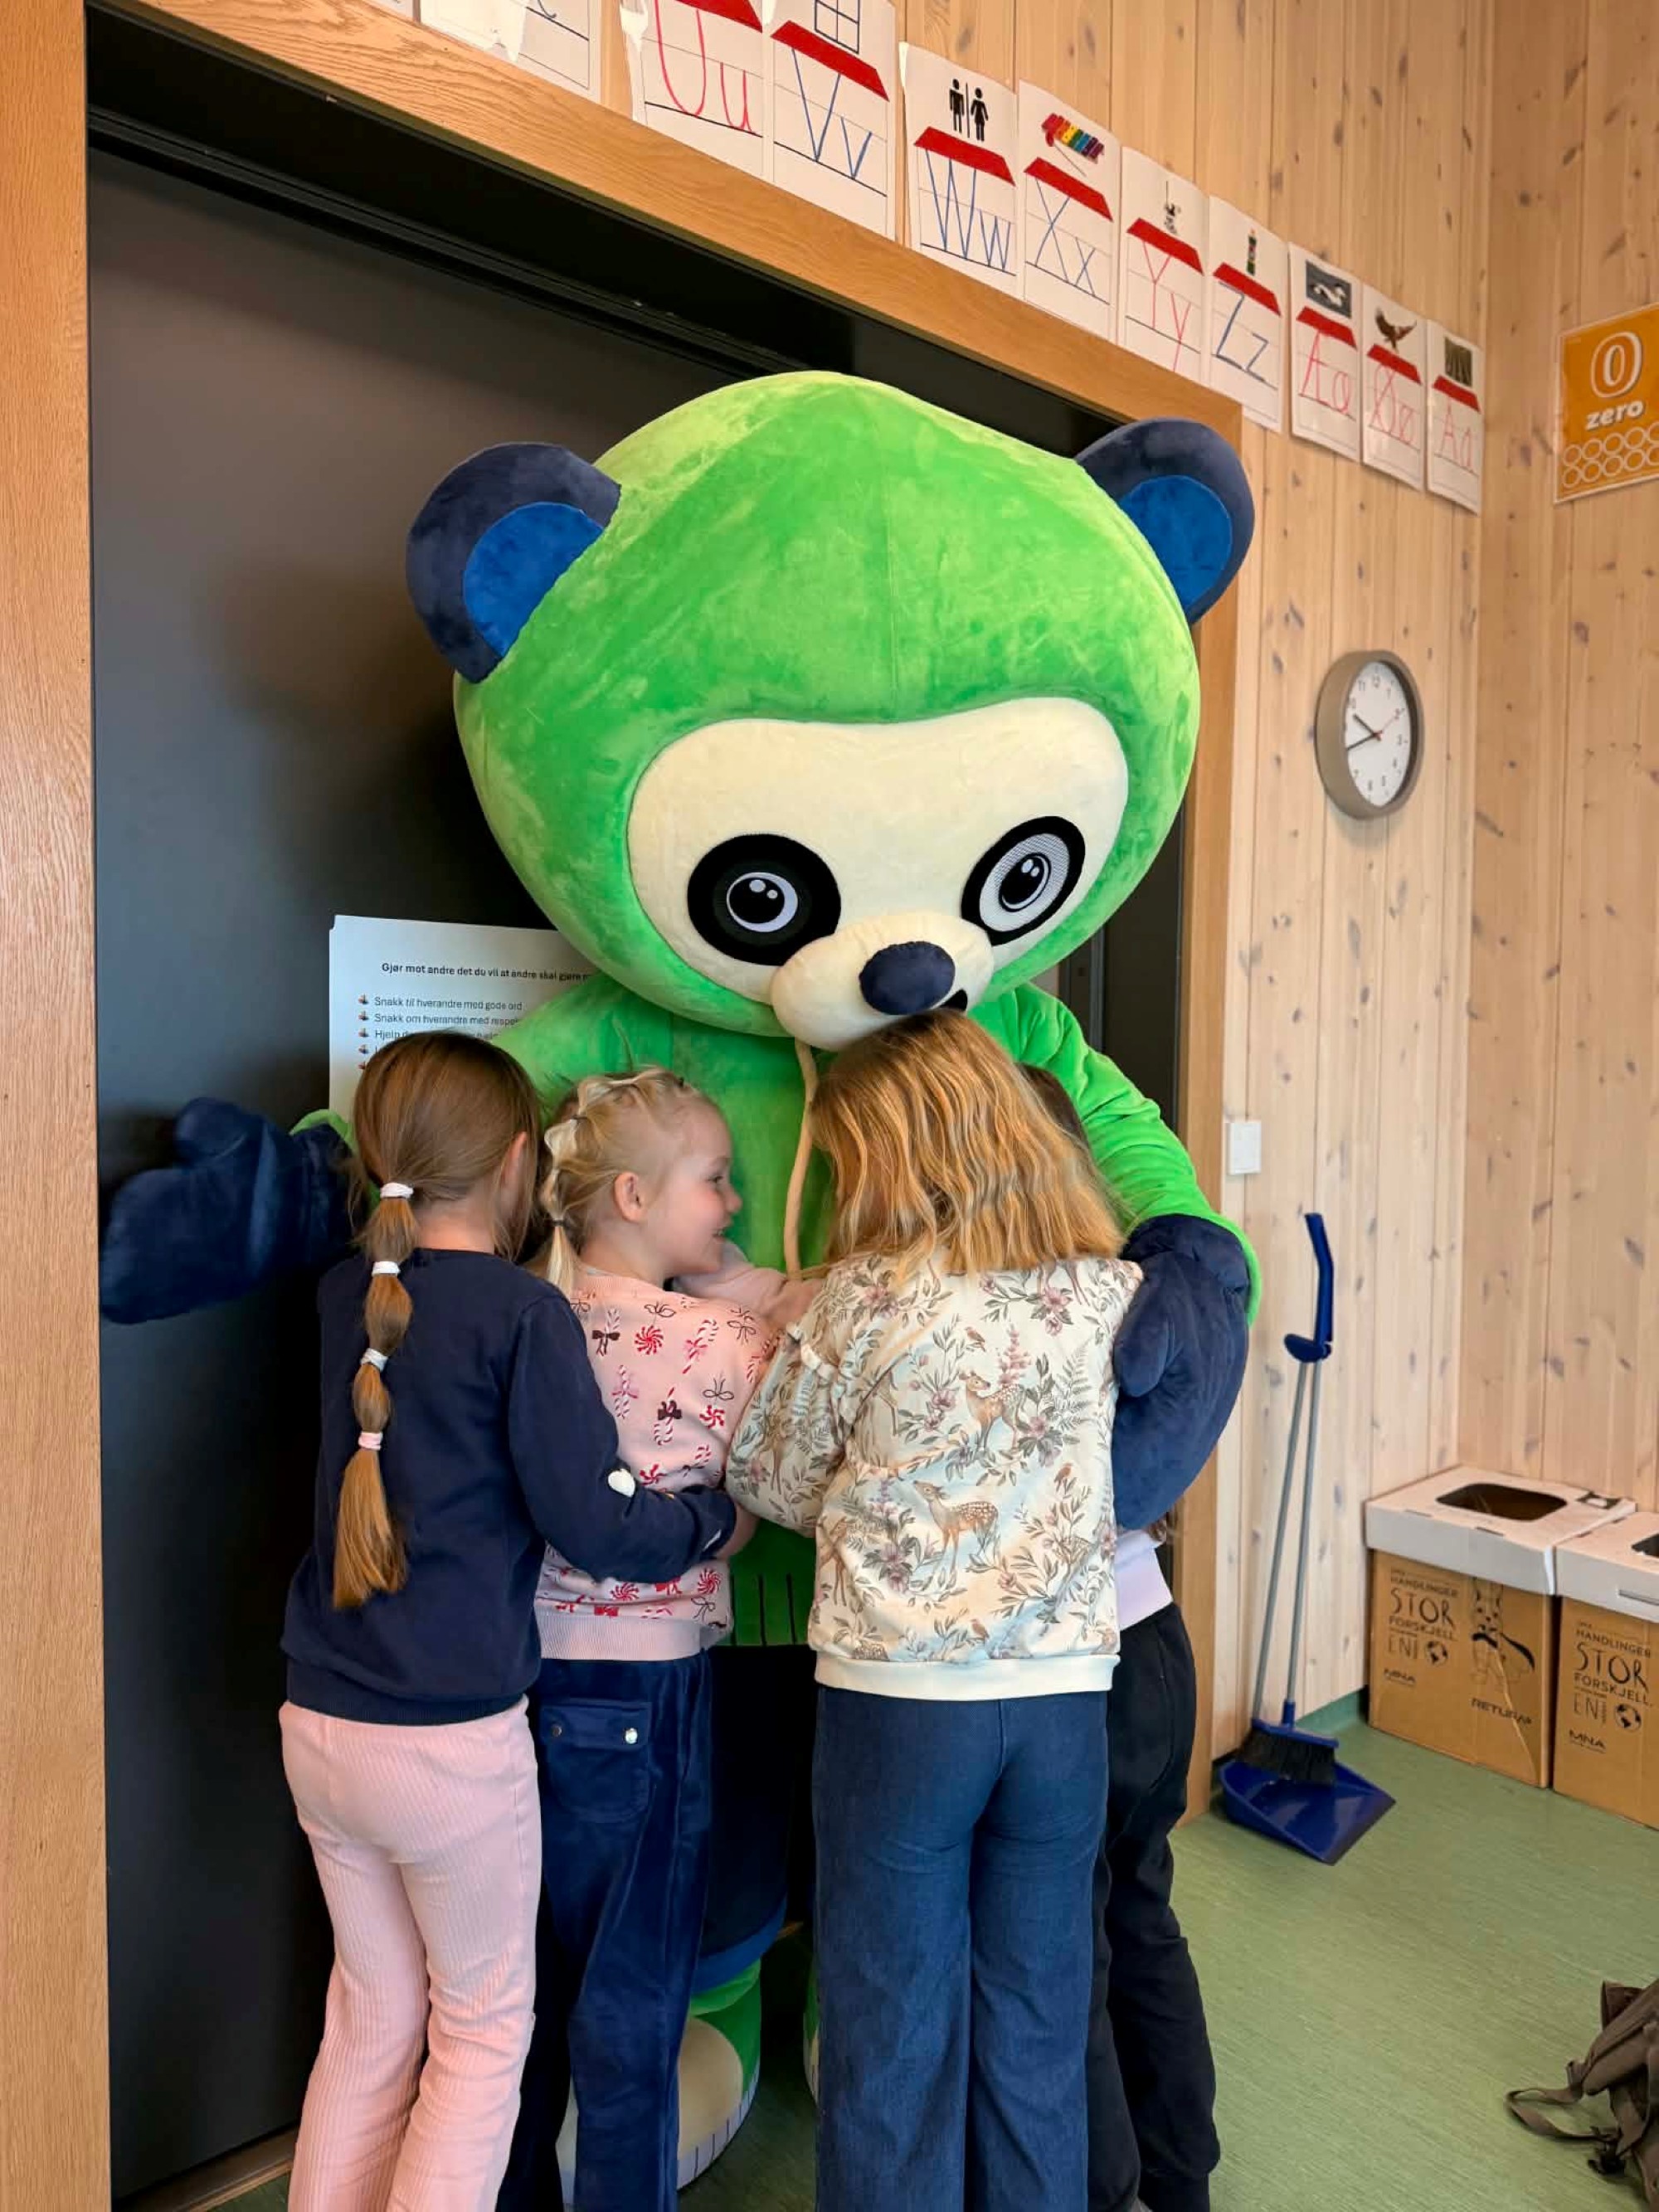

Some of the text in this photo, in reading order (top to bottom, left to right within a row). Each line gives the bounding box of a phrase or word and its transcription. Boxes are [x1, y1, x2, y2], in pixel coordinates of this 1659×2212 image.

[791, 47, 873, 180] Vv
[924, 148, 1012, 273] Ww
[1035, 177, 1097, 298] Xx
[1143, 241, 1191, 372] Yy
[1216, 281, 1269, 382] Zz
[1590, 332, 1642, 398] 0
[1586, 401, 1644, 430] zero
[382, 963, 403, 974] Gjør
[406, 965, 426, 974] mot
[428, 965, 455, 975] andre
[458, 967, 474, 975] det
[474, 968, 487, 976] du
[488, 969, 499, 977] vil
[511, 970, 537, 979] andre
[374, 997, 404, 1007] Snakk
[406, 998, 416, 1007] til
[416, 999, 462, 1009] hverandre
[465, 1000, 484, 1009] med
[485, 1002, 506, 1011] gode
[374, 1014, 404, 1023] Snakk
[406, 1015, 421, 1023] om
[423, 1015, 468, 1025] hverandre
[469, 1017, 489, 1025] med
[1390, 1587, 1457, 1631] STOR
[1576, 1629, 1652, 1659] HANDLINGER
[1577, 1641, 1649, 1694] STOR
